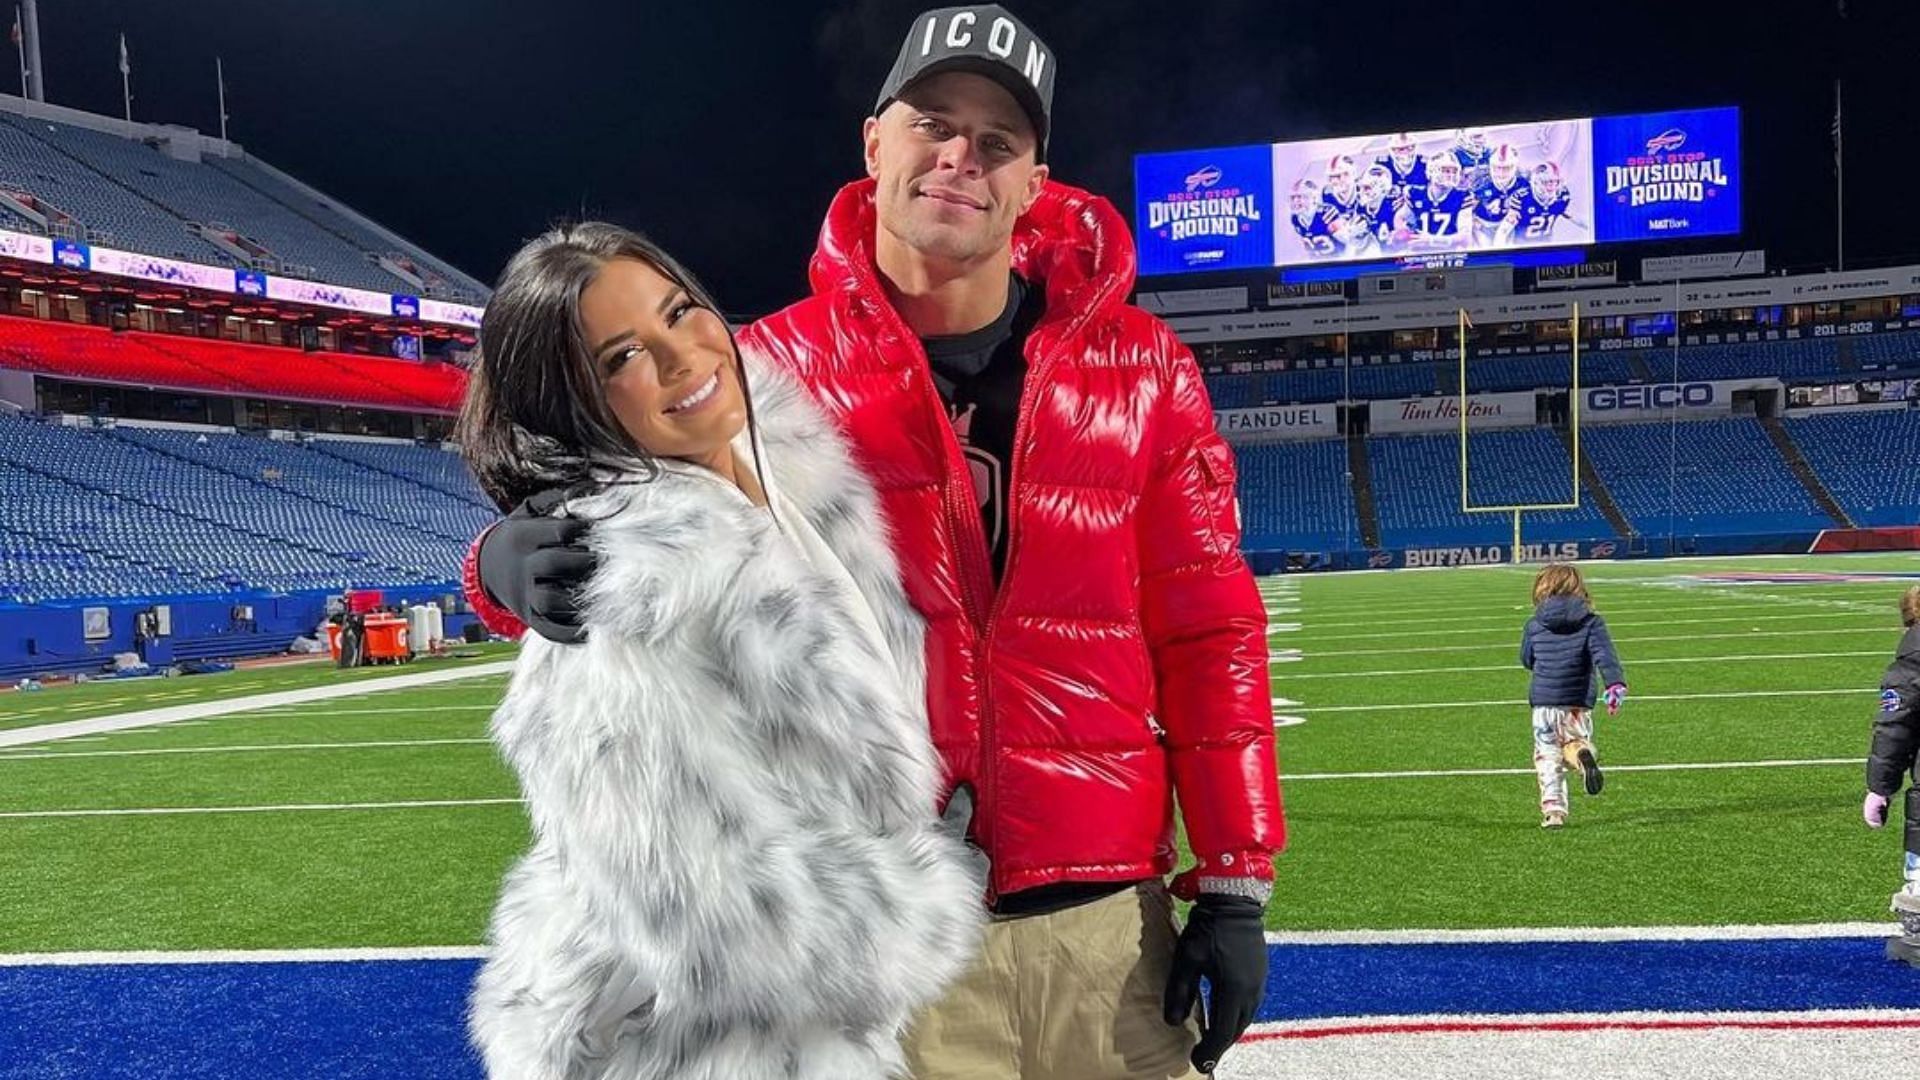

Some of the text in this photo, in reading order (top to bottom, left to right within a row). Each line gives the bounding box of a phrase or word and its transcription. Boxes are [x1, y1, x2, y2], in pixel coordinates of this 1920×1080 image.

[922, 12, 1046, 88] ICON
[1606, 158, 1727, 194] DIVISIONAL
[1631, 182, 1704, 207] ROUND
[1148, 194, 1260, 229] DIVISIONAL
[1171, 217, 1238, 240] ROUND
[1420, 212, 1451, 236] 17
[1526, 215, 1557, 237] 21
[1588, 383, 1714, 411] GEICO
[1228, 409, 1323, 430] FANDUEL
[1401, 400, 1432, 420] Tim
[1405, 546, 1501, 567] BUFFALO
